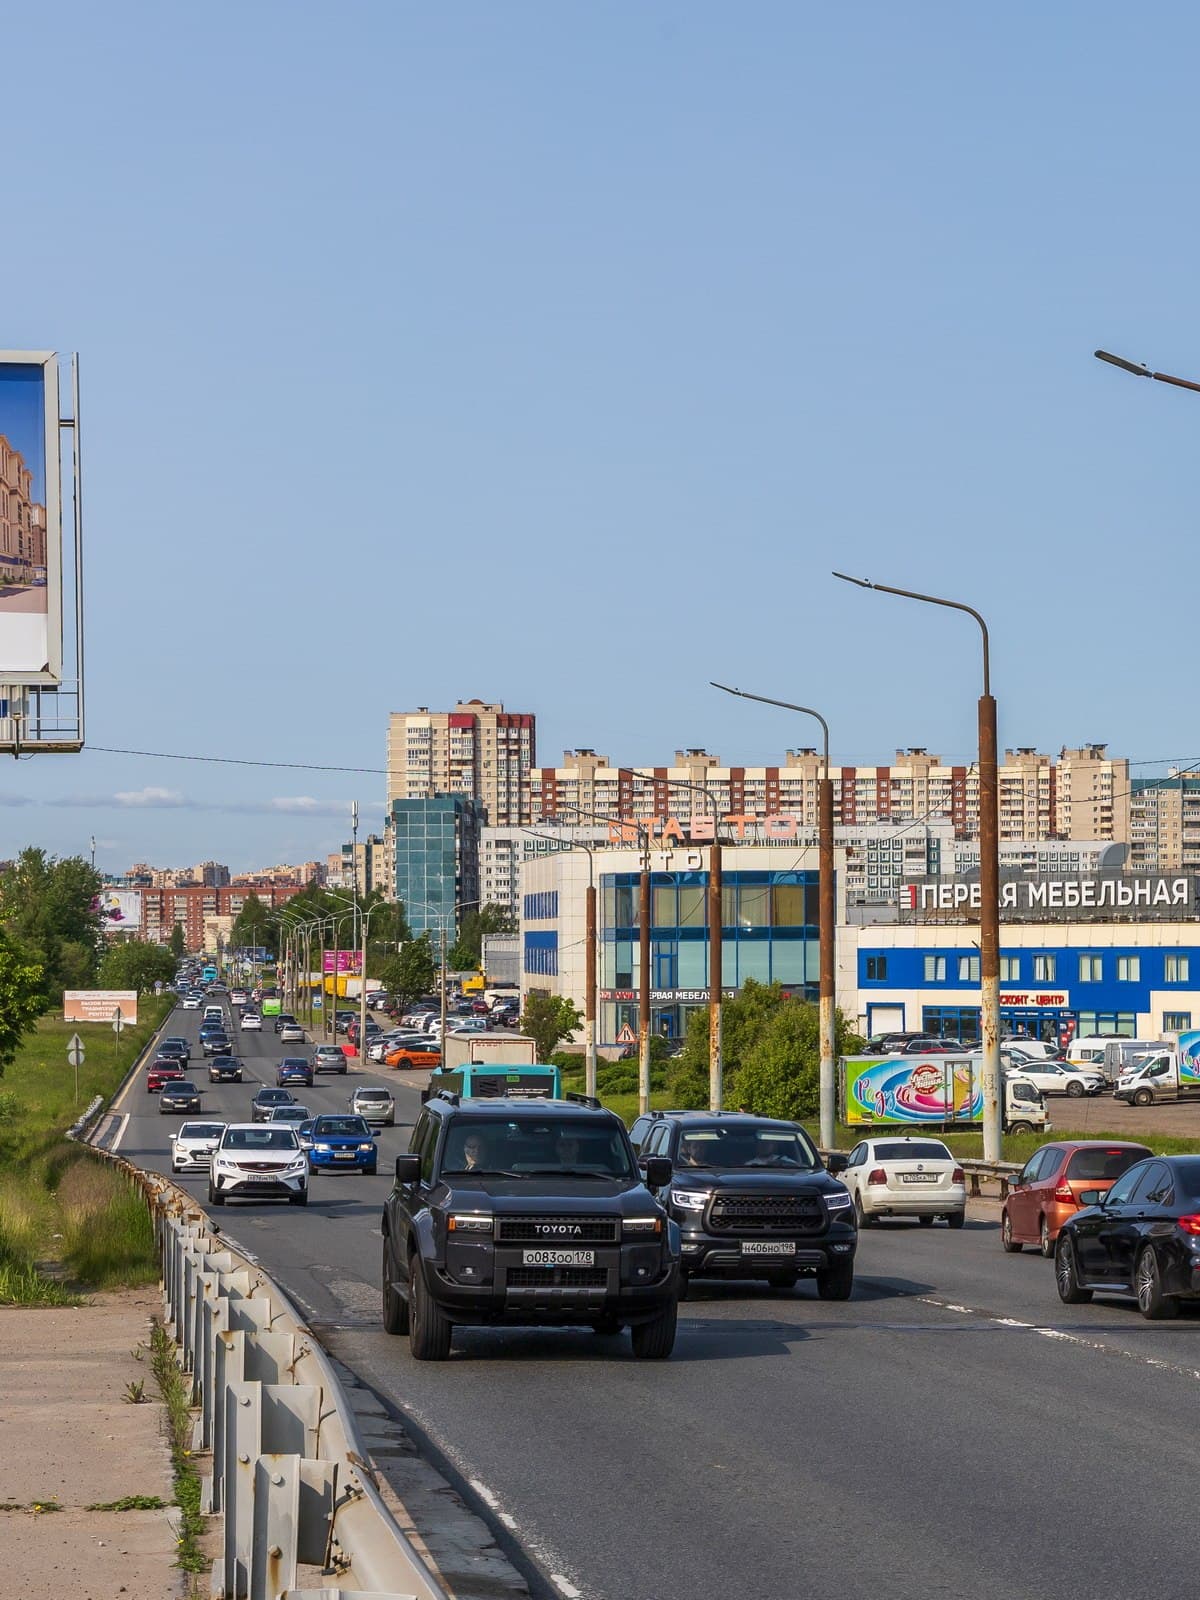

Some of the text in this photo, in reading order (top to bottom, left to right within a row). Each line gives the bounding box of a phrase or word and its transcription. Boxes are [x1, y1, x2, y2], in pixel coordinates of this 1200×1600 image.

[921, 878, 1189, 909] ПЕРВЯ МЕБЕЛЬНАЯ
[1036, 994, 1064, 1006] ЦЕНТР
[534, 1225, 582, 1234] TOYOTA
